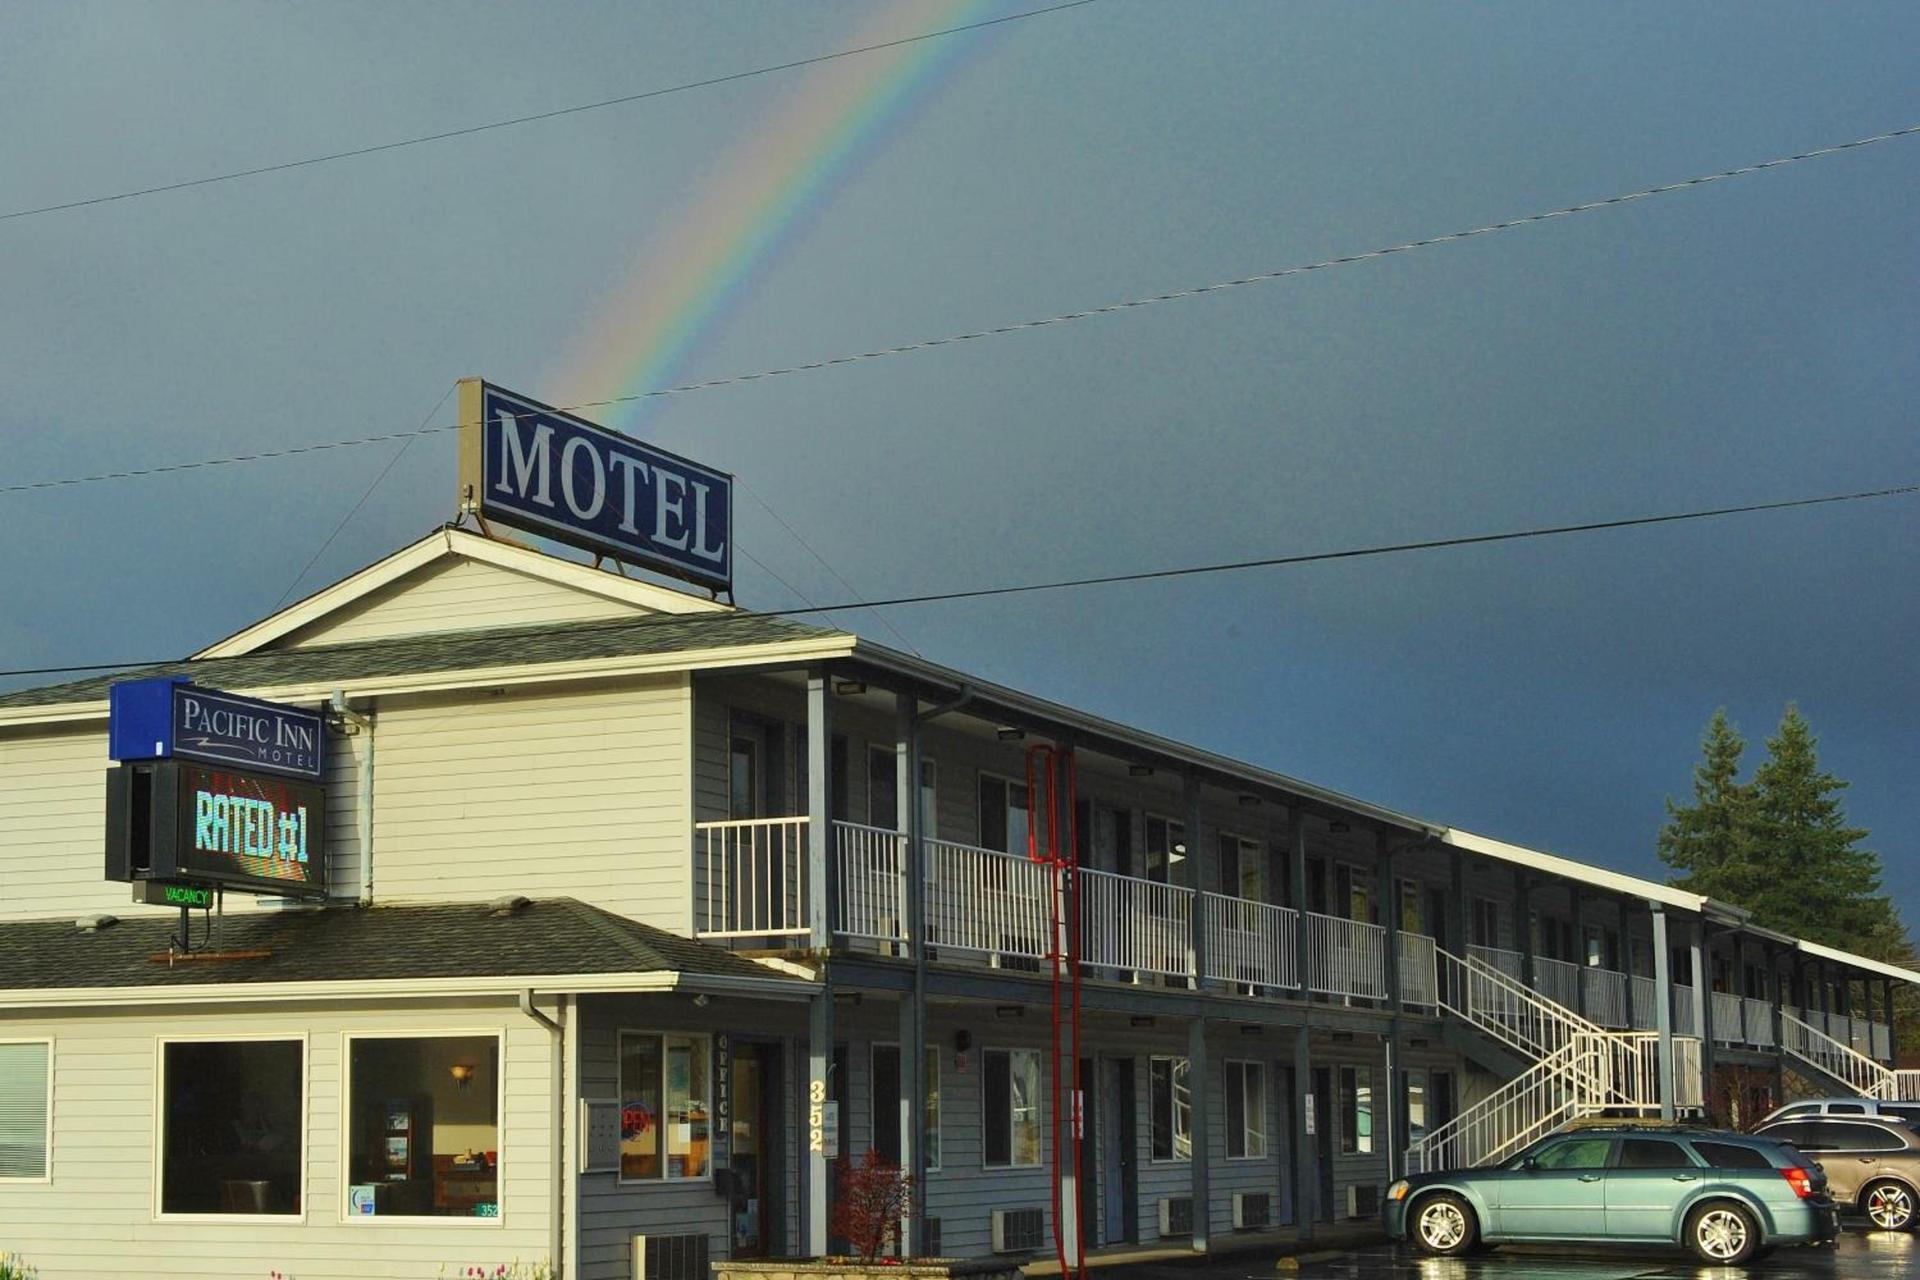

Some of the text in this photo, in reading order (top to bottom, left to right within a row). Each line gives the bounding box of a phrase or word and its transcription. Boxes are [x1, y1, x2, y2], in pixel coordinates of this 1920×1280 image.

[494, 408, 725, 563] MOTEL
[184, 698, 313, 752] PACIFIC INN
[258, 747, 314, 768] MOTEL
[195, 791, 309, 863] RATED #1
[165, 886, 209, 905] VACANCY
[719, 1034, 729, 1132] OFFICE
[810, 1080, 825, 1152] 352
[481, 1204, 498, 1217] 352
